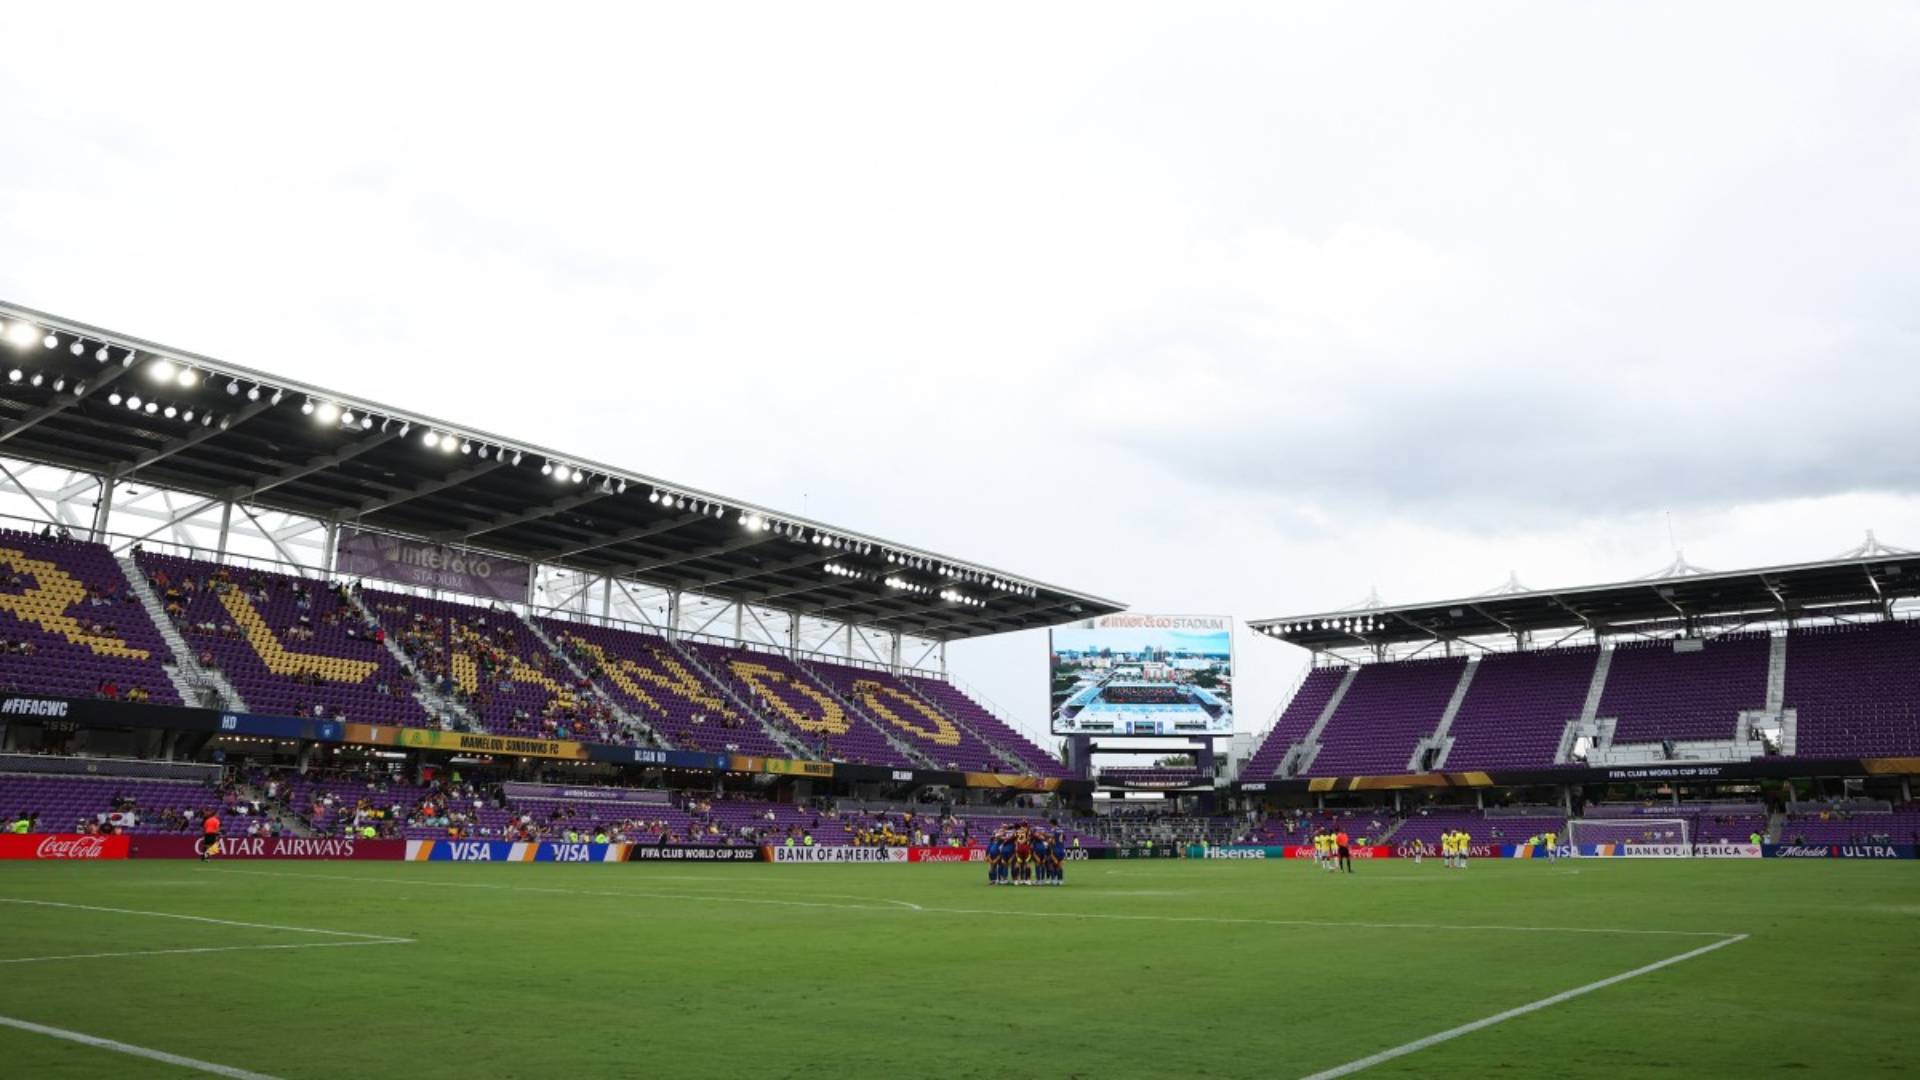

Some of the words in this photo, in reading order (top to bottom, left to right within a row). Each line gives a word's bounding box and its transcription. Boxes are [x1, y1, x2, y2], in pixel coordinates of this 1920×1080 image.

[413, 568, 463, 588] STADIUM
[1173, 618, 1223, 630] STADIUM
[1, 698, 68, 717] #FIFACWC
[222, 715, 237, 730] HD
[549, 742, 560, 754] FC
[36, 836, 107, 857] Coca-Cola
[273, 839, 354, 856] AIRWAYS
[449, 842, 491, 860] VISA
[552, 843, 590, 861] VISA
[1397, 846, 1436, 857] QAAR
[1555, 845, 1580, 857] ISA
[1626, 845, 1661, 856] BANK
[1663, 845, 1680, 856] OF
[1842, 846, 1897, 857] ULTRA
[640, 848, 660, 859] FIFA
[662, 848, 683, 859] CLUB
[684, 848, 716, 859] WORLD
[717, 849, 733, 859] CUP
[778, 848, 813, 861] BANK
[817, 849, 832, 861] OF
[836, 849, 890, 861] AMERICA
[1203, 847, 1265, 859] Hisense
